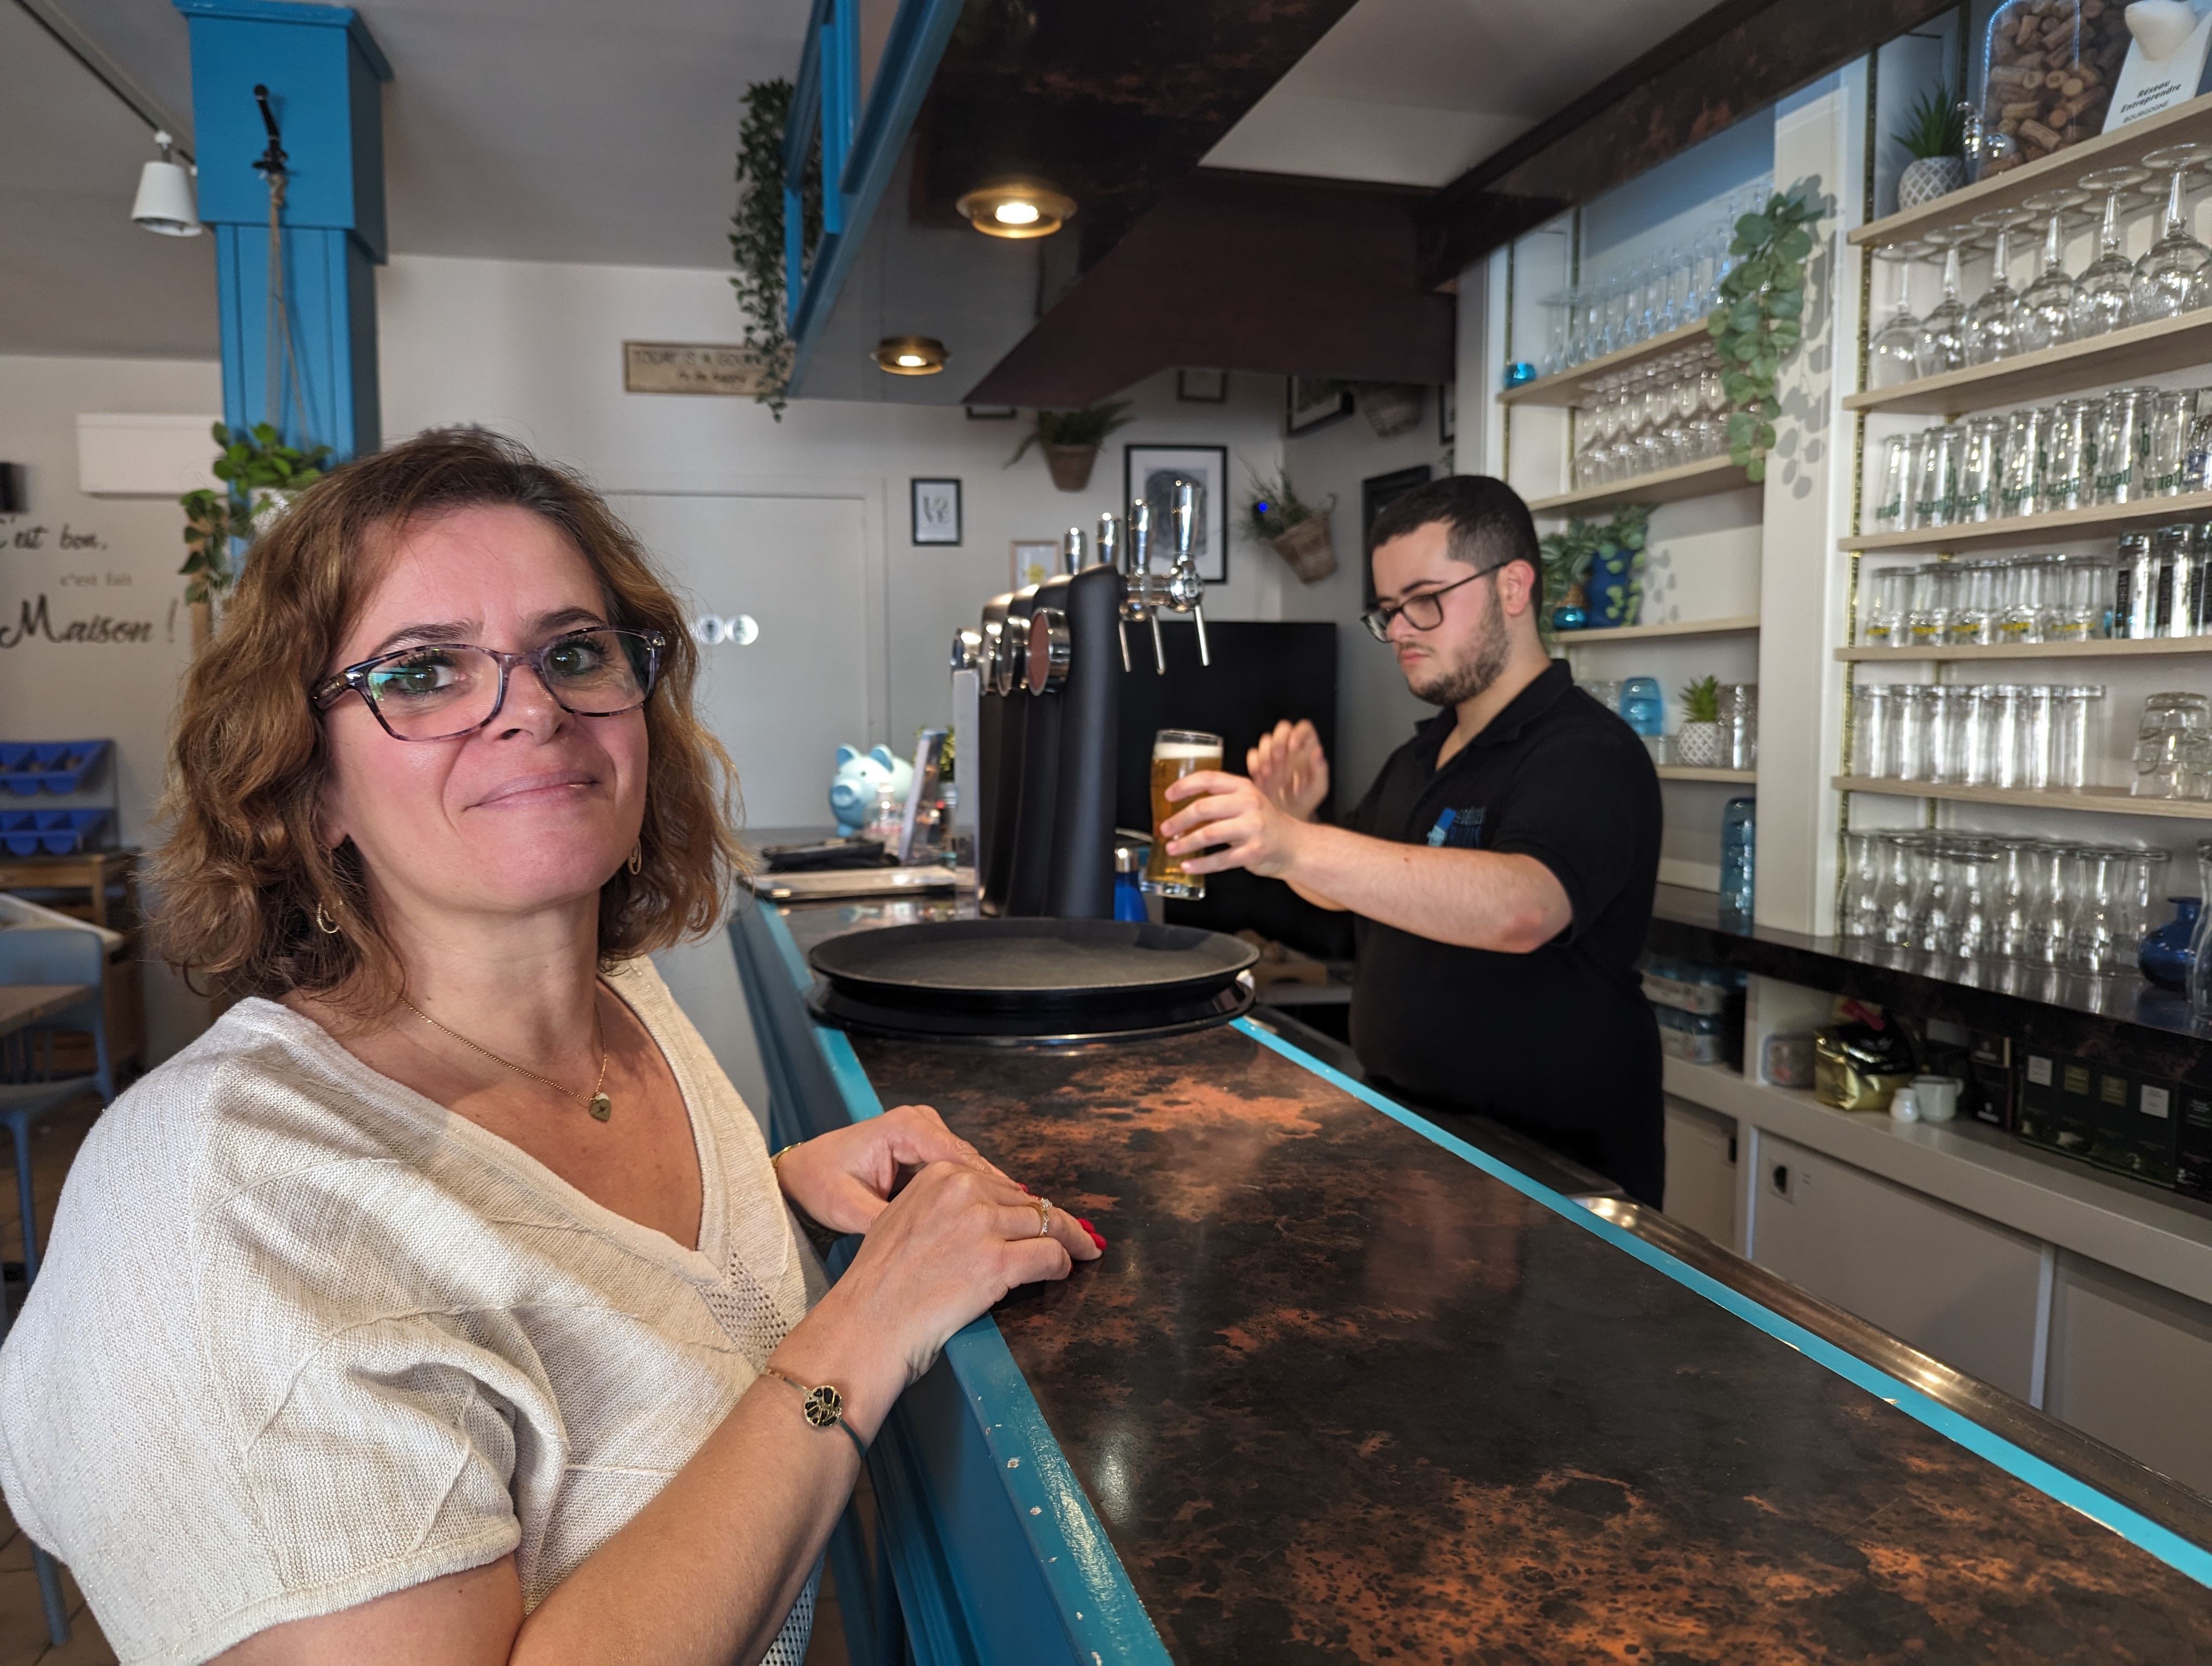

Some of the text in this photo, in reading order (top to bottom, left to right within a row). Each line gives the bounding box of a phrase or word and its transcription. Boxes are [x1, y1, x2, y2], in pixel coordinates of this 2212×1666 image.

[2120, 84, 2182, 113] Entreprendre
[2137, 80, 2171, 99] Réseau
[2123, 100, 2169, 123] BOURGOGNE
[0, 593, 179, 649] Maison !
